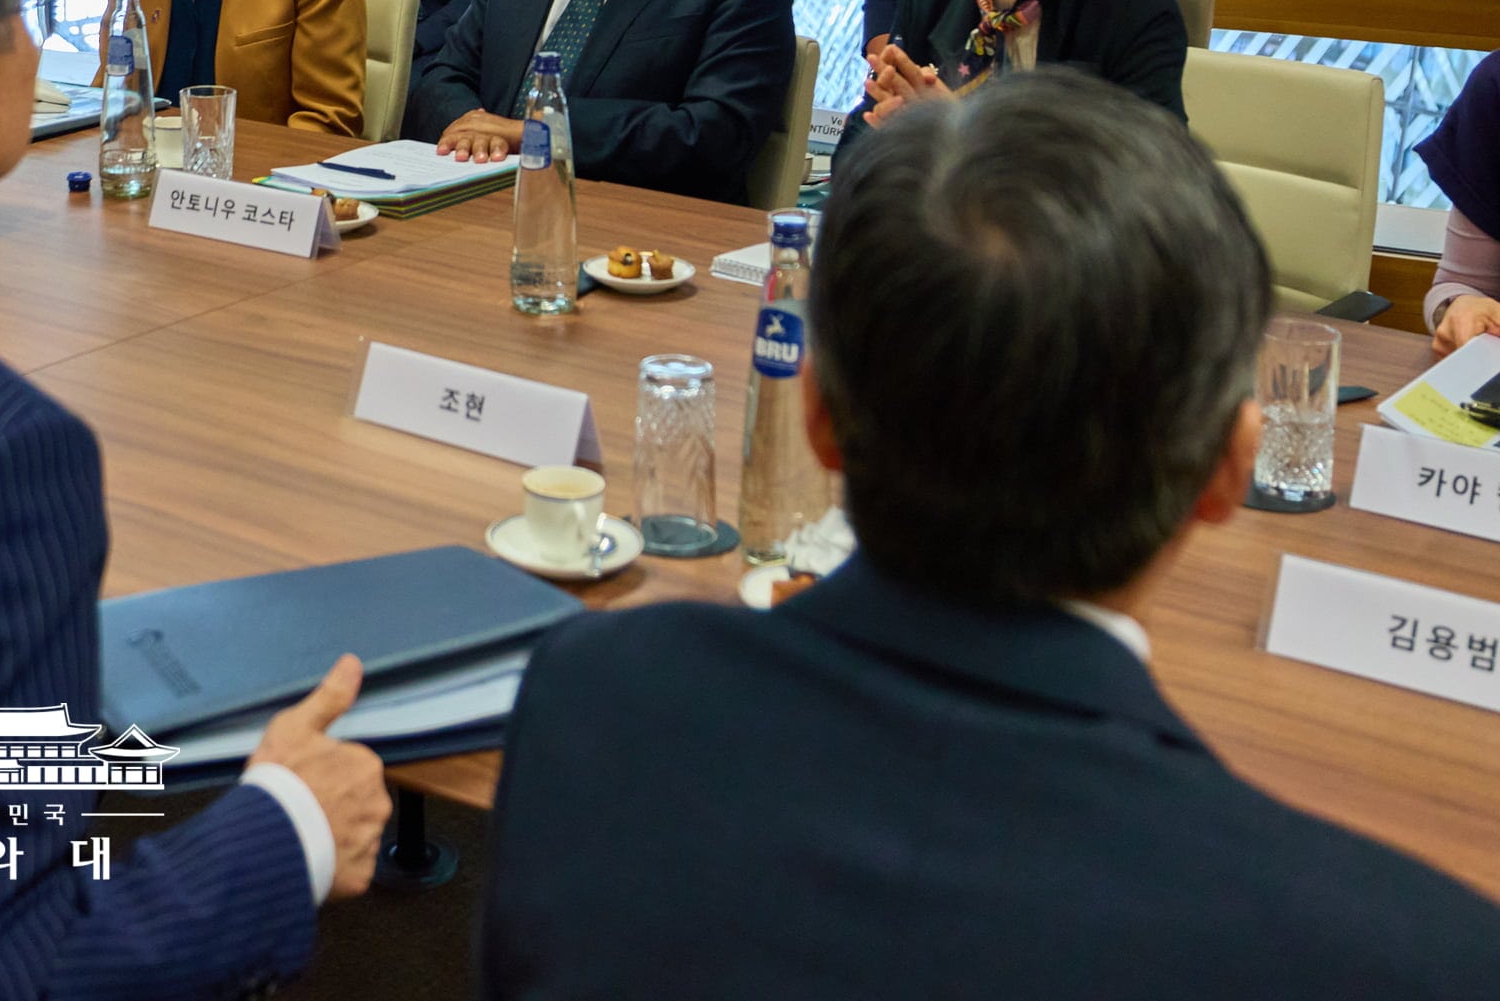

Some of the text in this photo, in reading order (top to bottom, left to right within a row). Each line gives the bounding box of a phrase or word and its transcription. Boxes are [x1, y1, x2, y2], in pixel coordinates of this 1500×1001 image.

[809, 124, 845, 137] NTÜRK
[831, 116, 843, 126] Ve
[170, 189, 296, 232] 안토니우 코스타
[755, 336, 799, 363] BRU
[438, 387, 486, 423] 조현
[1417, 466, 1482, 506] 카야
[1387, 613, 1499, 674] 김용범
